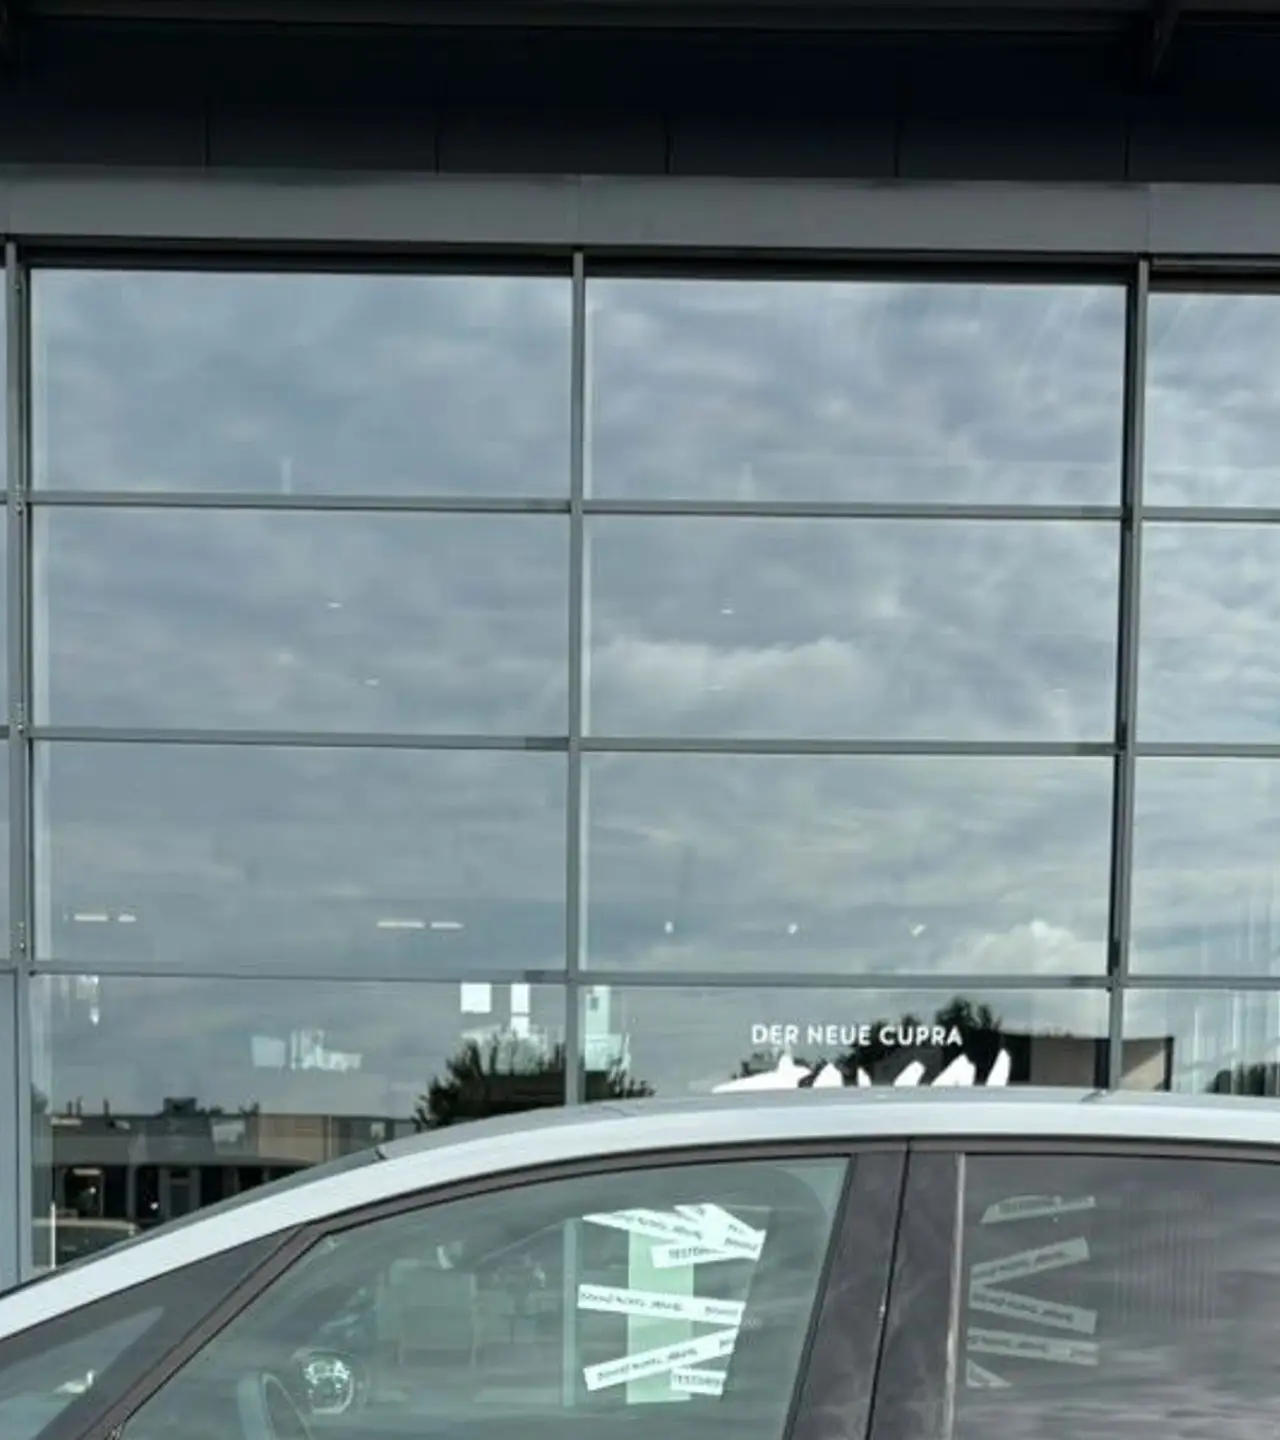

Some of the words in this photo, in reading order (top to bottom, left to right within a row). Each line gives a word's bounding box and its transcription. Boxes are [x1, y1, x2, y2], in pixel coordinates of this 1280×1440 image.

[750, 1023, 800, 1046] DER
[807, 1024, 872, 1047] NEUE
[878, 1024, 964, 1047] CUPRA
